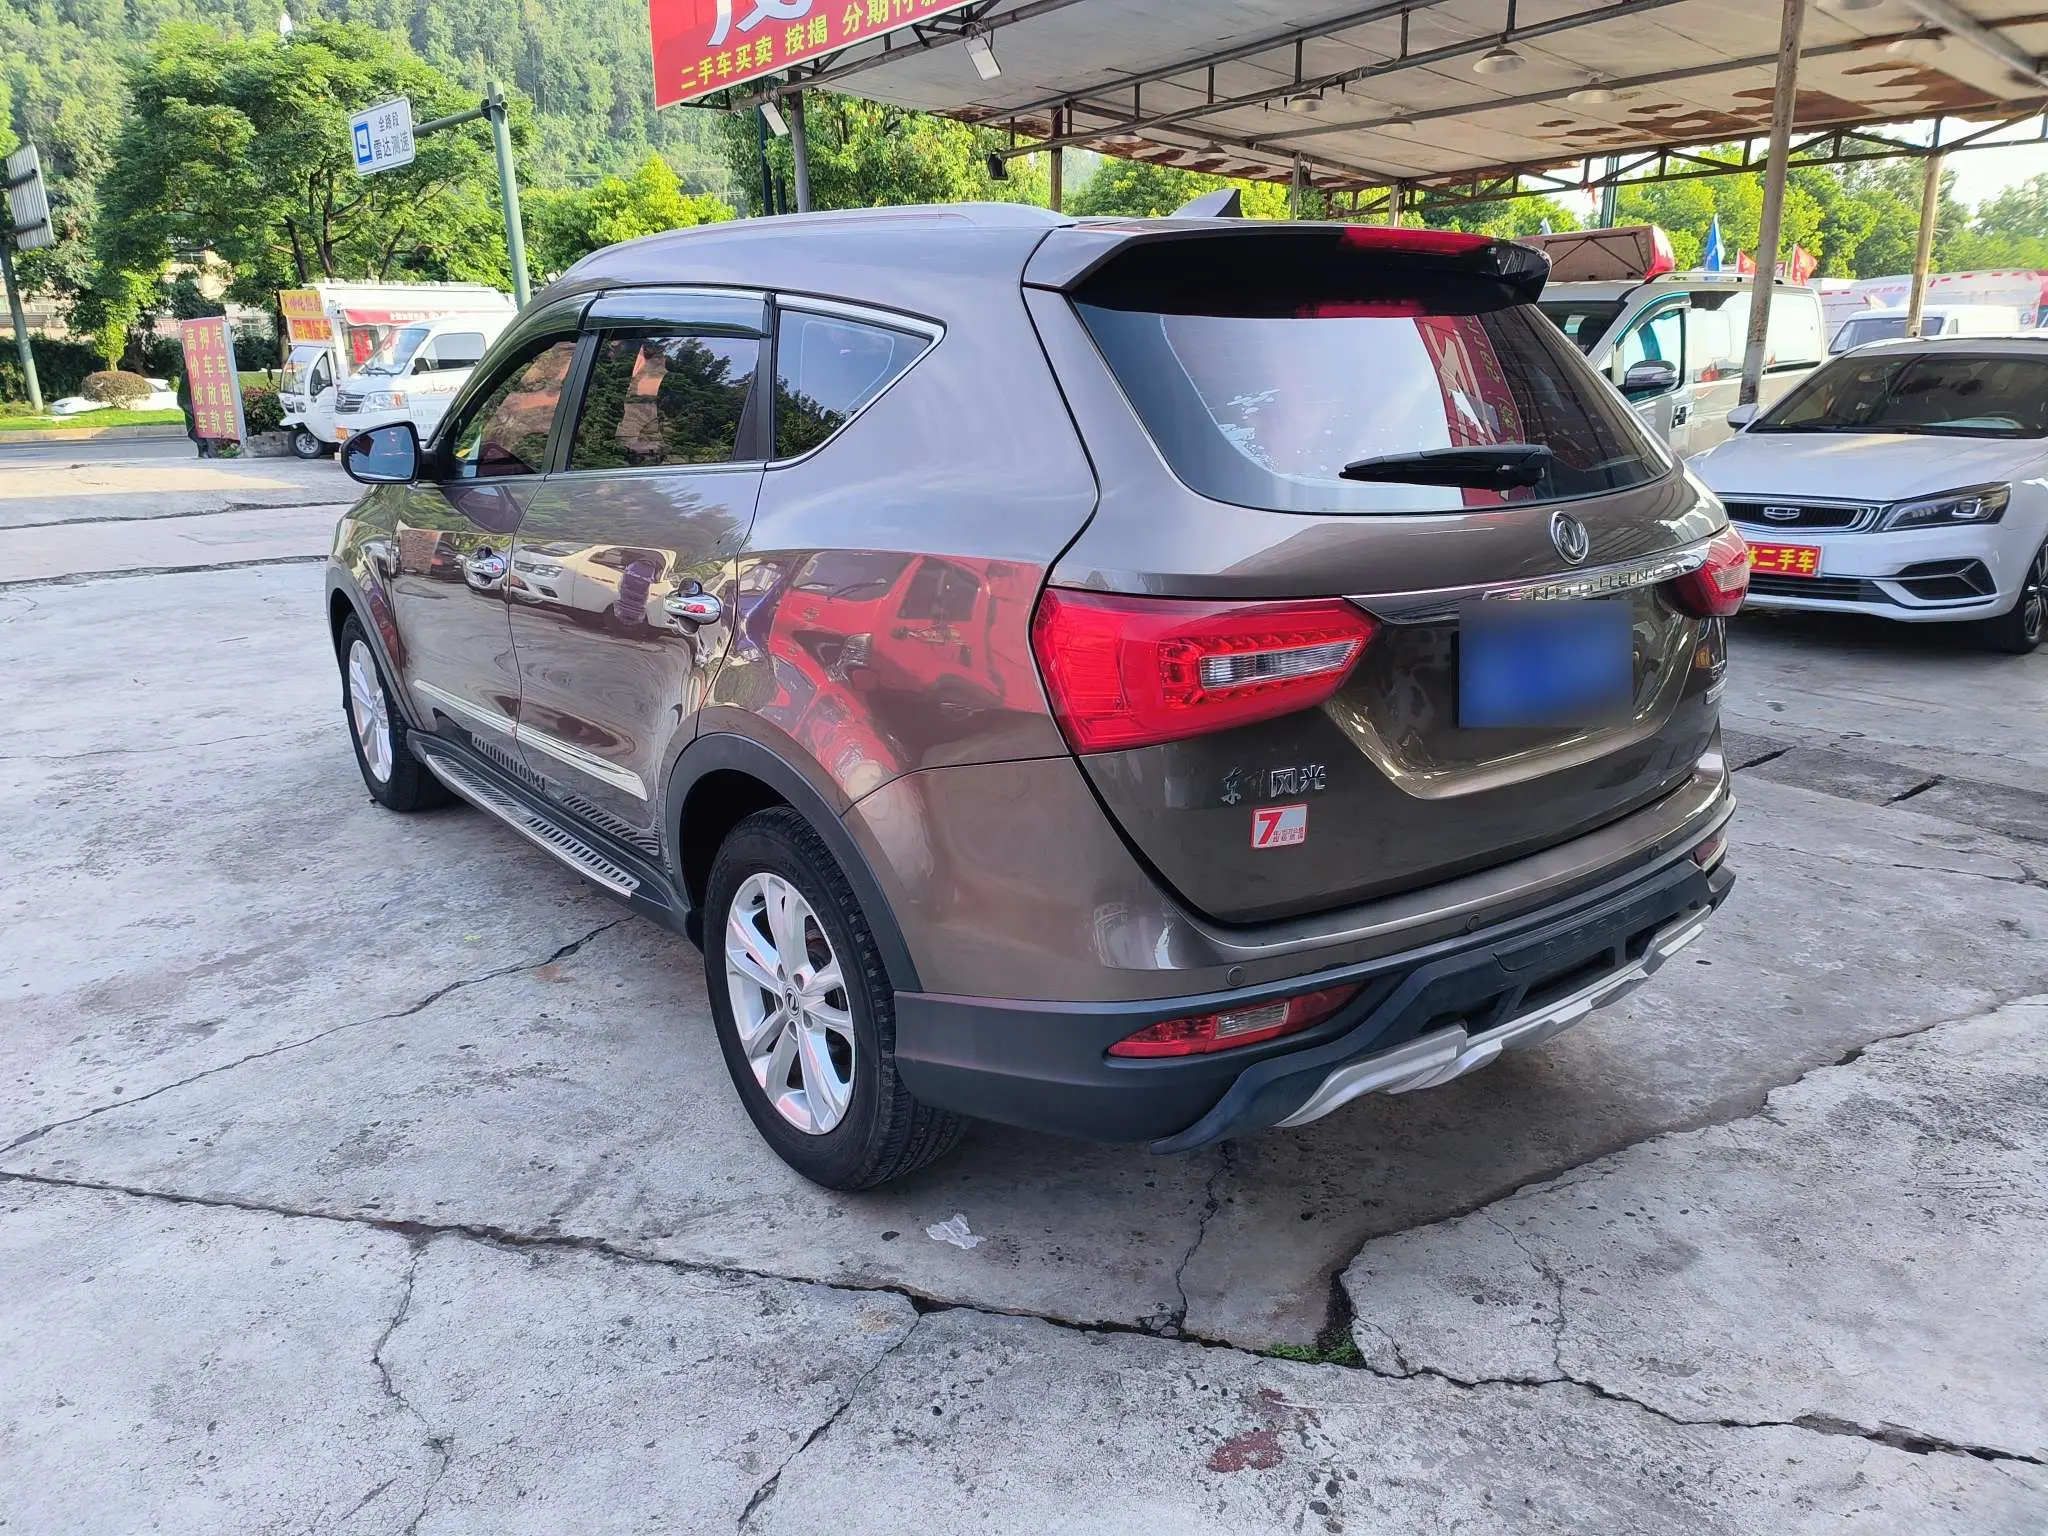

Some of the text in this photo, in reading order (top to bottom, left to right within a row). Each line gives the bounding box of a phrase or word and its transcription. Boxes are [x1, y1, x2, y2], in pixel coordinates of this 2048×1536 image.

[681, 36, 773, 90] 二手车买卖
[785, 14, 828, 56] 按揭
[842, 0, 938, 36] 分期付
[373, 129, 411, 161] 雷达测速
[378, 111, 400, 133] 全路段
[185, 328, 208, 434] 高价收车
[212, 324, 235, 434] 汽车租赁
[1258, 811, 1284, 845] 7
